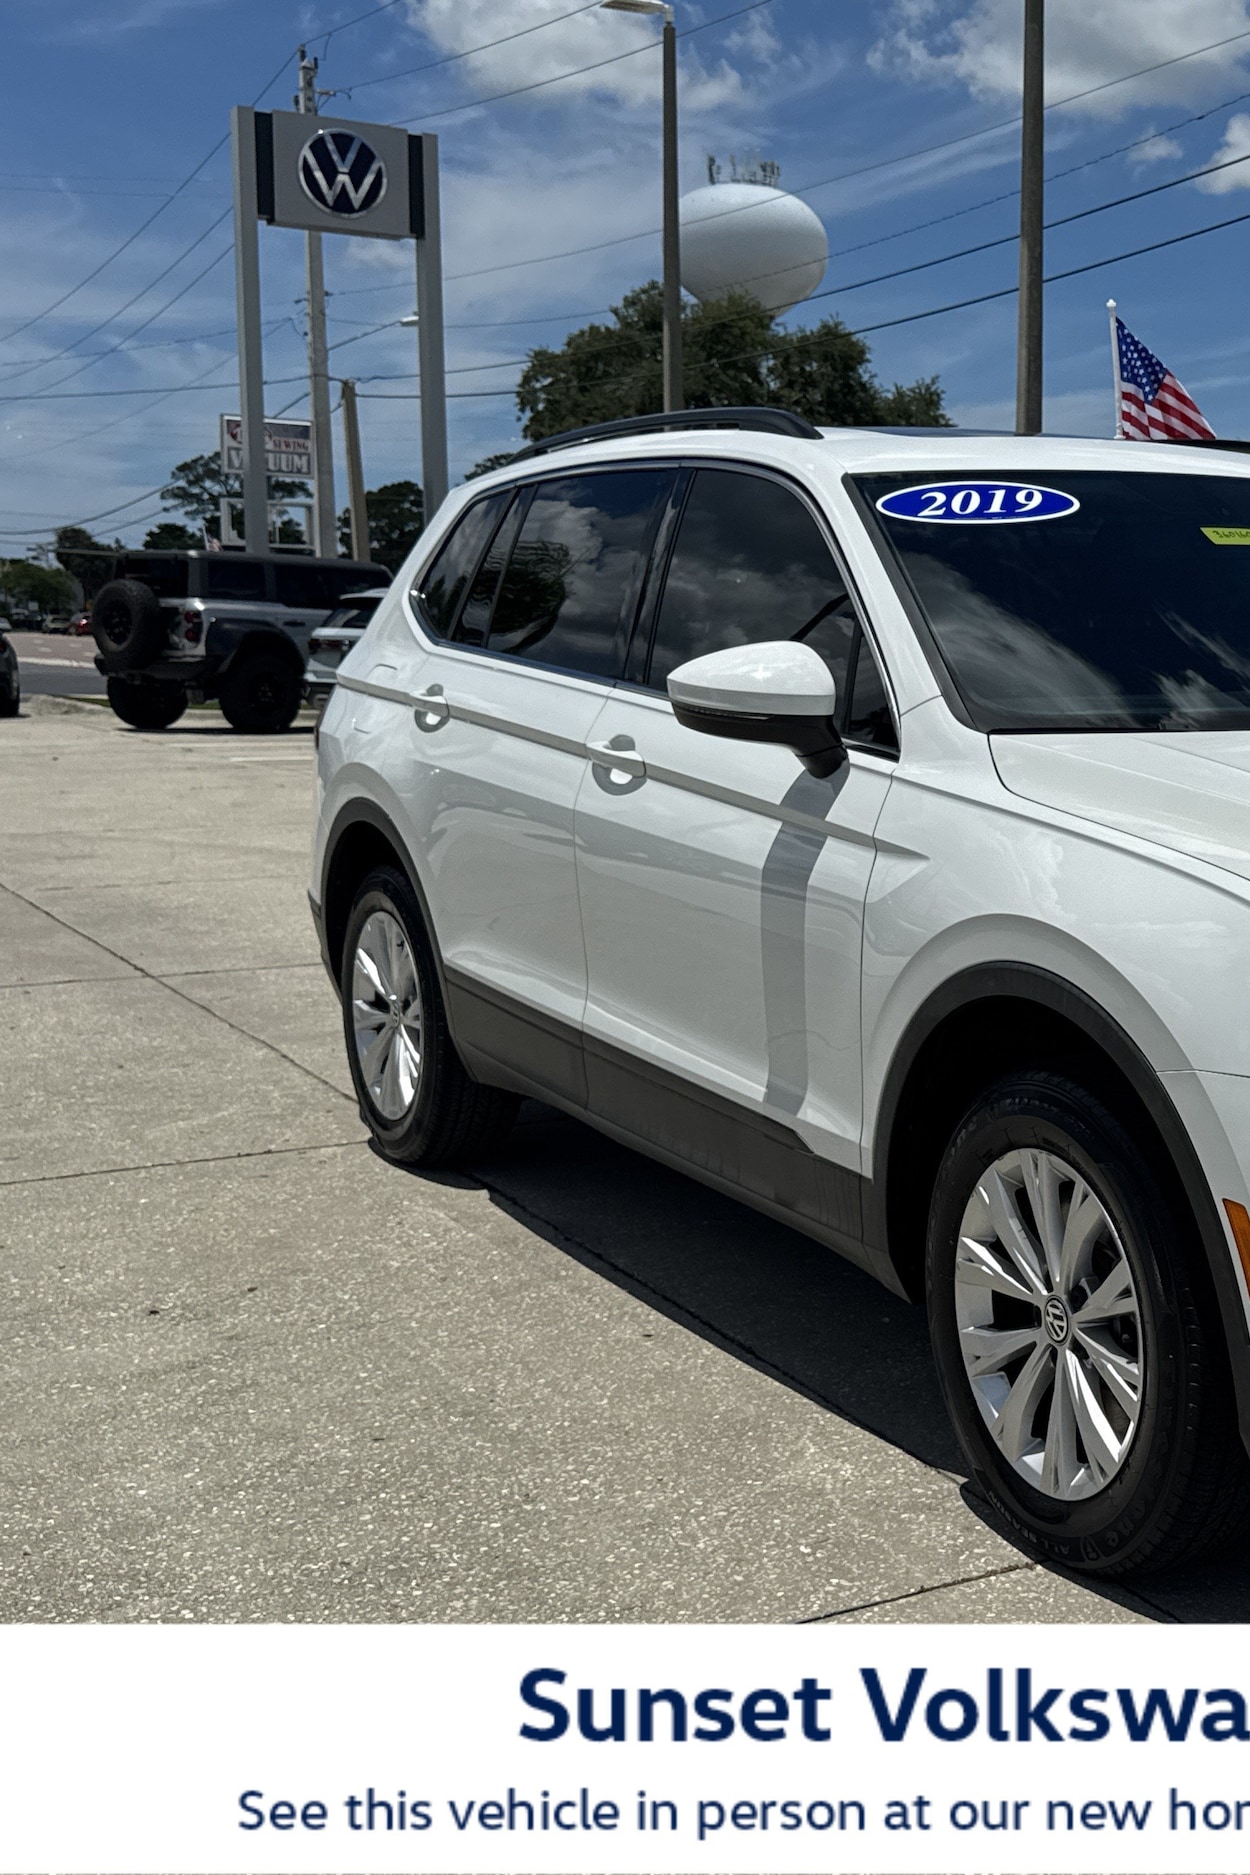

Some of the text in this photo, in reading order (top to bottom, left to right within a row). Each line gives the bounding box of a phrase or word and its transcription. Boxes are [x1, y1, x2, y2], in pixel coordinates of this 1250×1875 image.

[299, 129, 387, 217] VW
[230, 450, 309, 473] VUUM
[917, 489, 1043, 517] 2019
